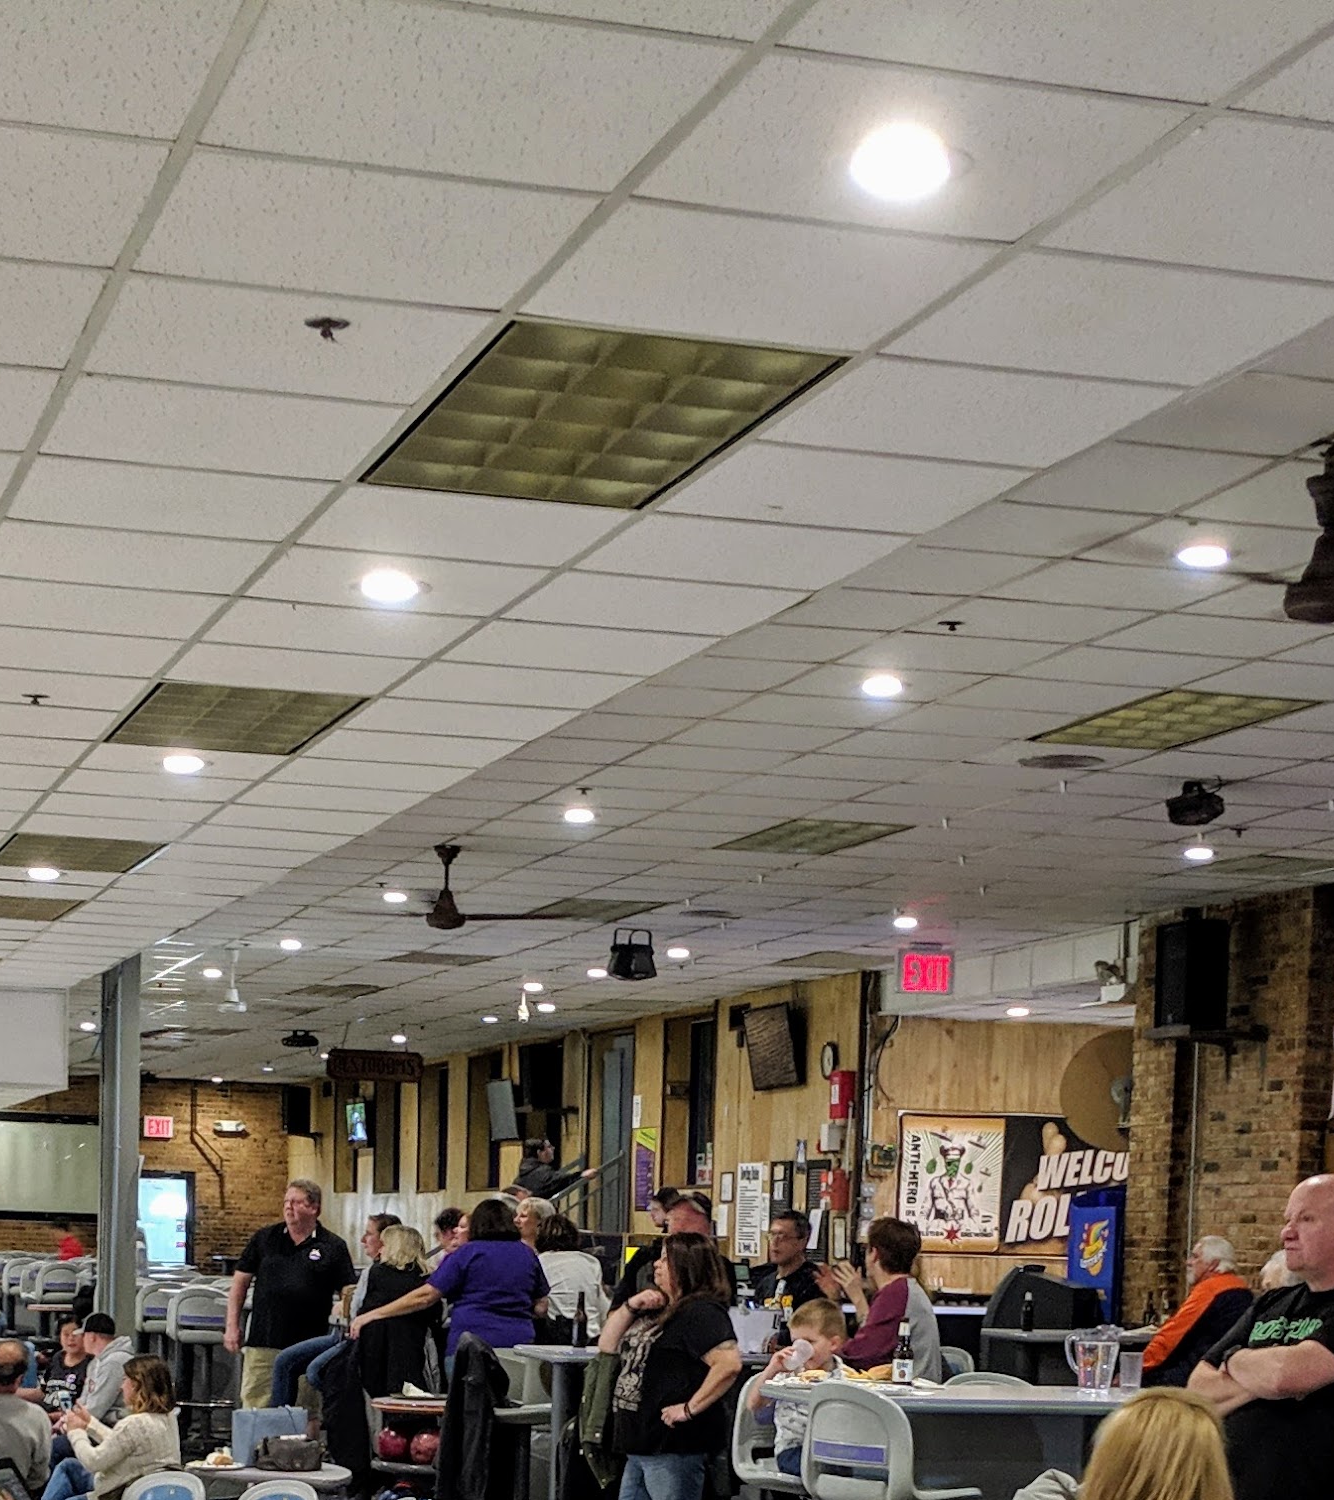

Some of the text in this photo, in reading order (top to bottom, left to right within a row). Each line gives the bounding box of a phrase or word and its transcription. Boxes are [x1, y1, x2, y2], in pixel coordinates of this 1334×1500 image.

[902, 953, 951, 992] EXIT
[148, 1119, 170, 1136] EXIT
[906, 1135, 921, 1204] ANTI-HERO
